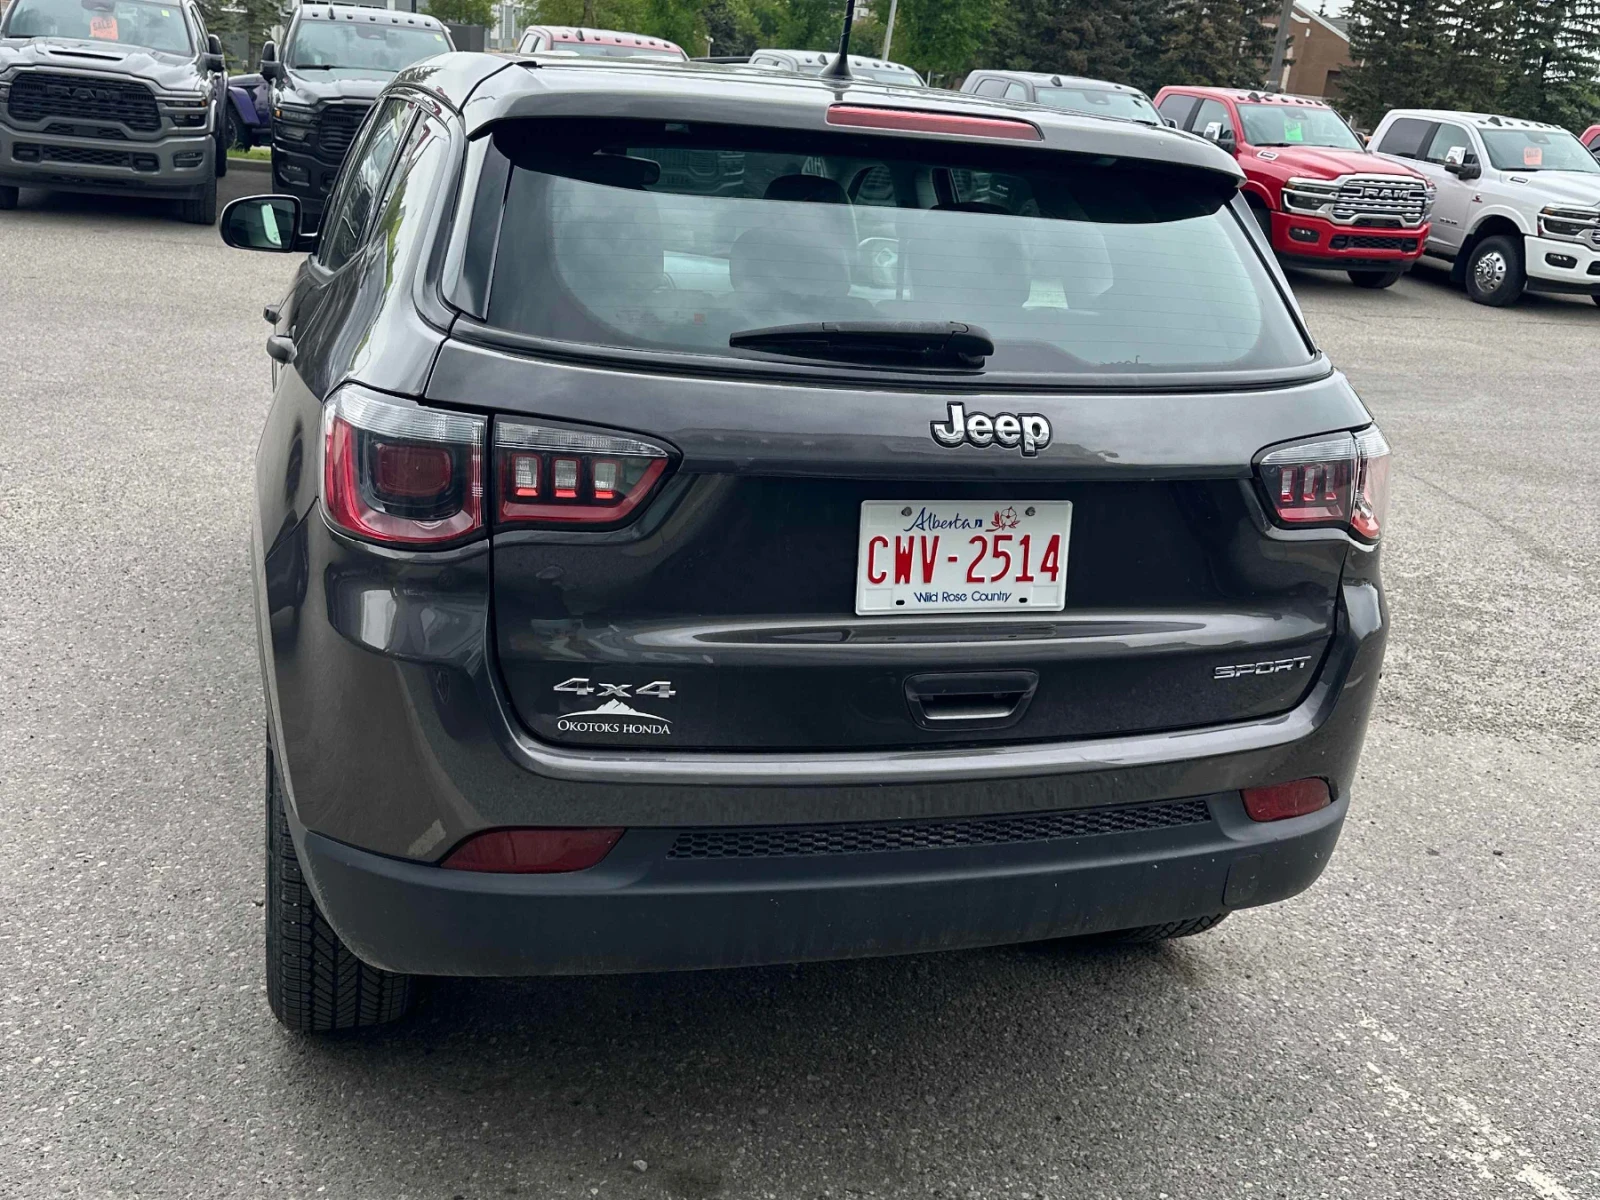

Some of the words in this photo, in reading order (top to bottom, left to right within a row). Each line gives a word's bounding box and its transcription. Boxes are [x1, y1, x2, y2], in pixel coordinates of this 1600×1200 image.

[45, 84, 121, 100] RAM
[1363, 187, 1409, 199] RAM
[930, 401, 1053, 457] Jeep
[903, 506, 972, 532] Alberta
[867, 534, 1061, 585] CWV-2514
[913, 591, 938, 603] Wild
[941, 590, 968, 602] Rose
[971, 589, 1013, 602] Country
[1213, 655, 1313, 679] SPORT
[557, 719, 620, 733] OKOTOKS
[622, 723, 672, 735] HONDA
